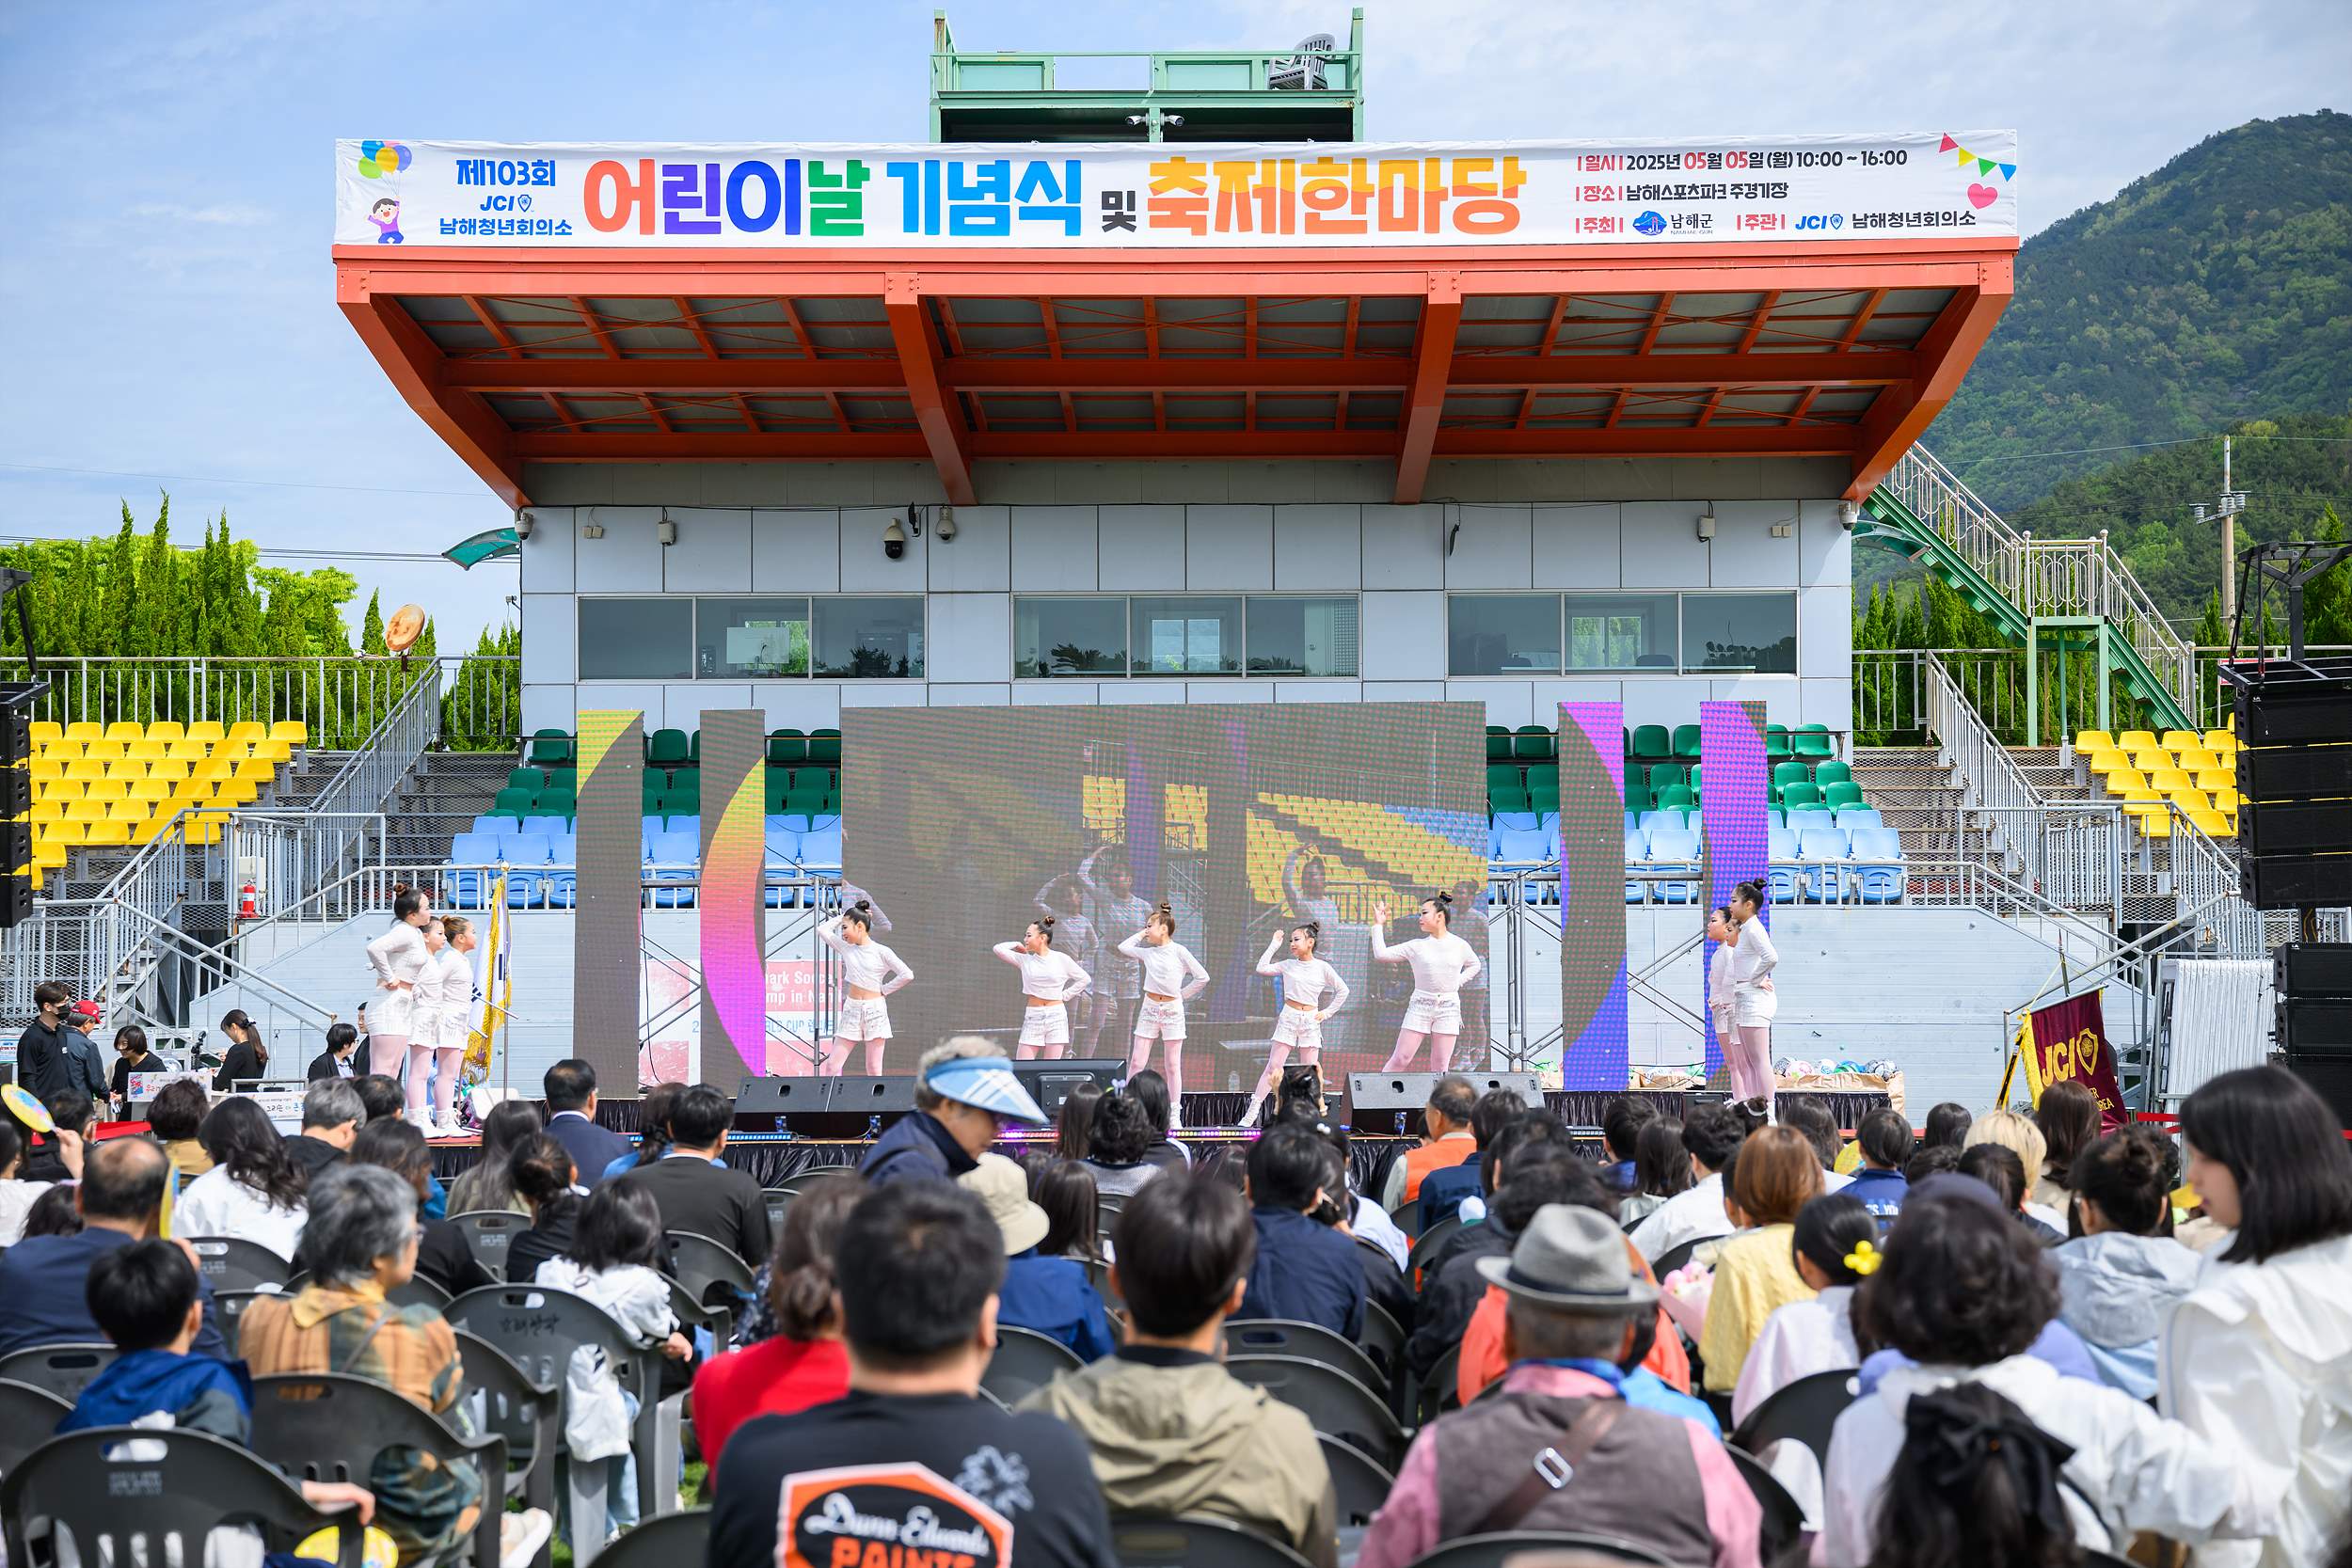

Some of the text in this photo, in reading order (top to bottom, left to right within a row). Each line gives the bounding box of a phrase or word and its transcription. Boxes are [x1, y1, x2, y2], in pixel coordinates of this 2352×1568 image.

[1627, 153, 1681, 170] 2025년
[1684, 152, 1723, 169] 05월
[1725, 150, 1764, 169] 05일
[1767, 150, 1793, 169] (월)
[1797, 150, 1843, 167] 10:00
[1861, 150, 1908, 166] 16:00
[456, 158, 556, 187] 제103회
[583, 156, 1527, 236] 어린이날 기념식 및 축제한마당
[1627, 183, 1727, 201] 남해스포츠파크
[1730, 182, 1789, 199] 주경기장
[479, 196, 514, 212] JCI
[439, 218, 572, 236] 남해청년회의소
[1670, 214, 1713, 229] 남해군
[1795, 215, 1827, 230] JCI
[1851, 211, 1977, 229] 남해청년회의소
[2042, 1037, 2077, 1087] JCI
